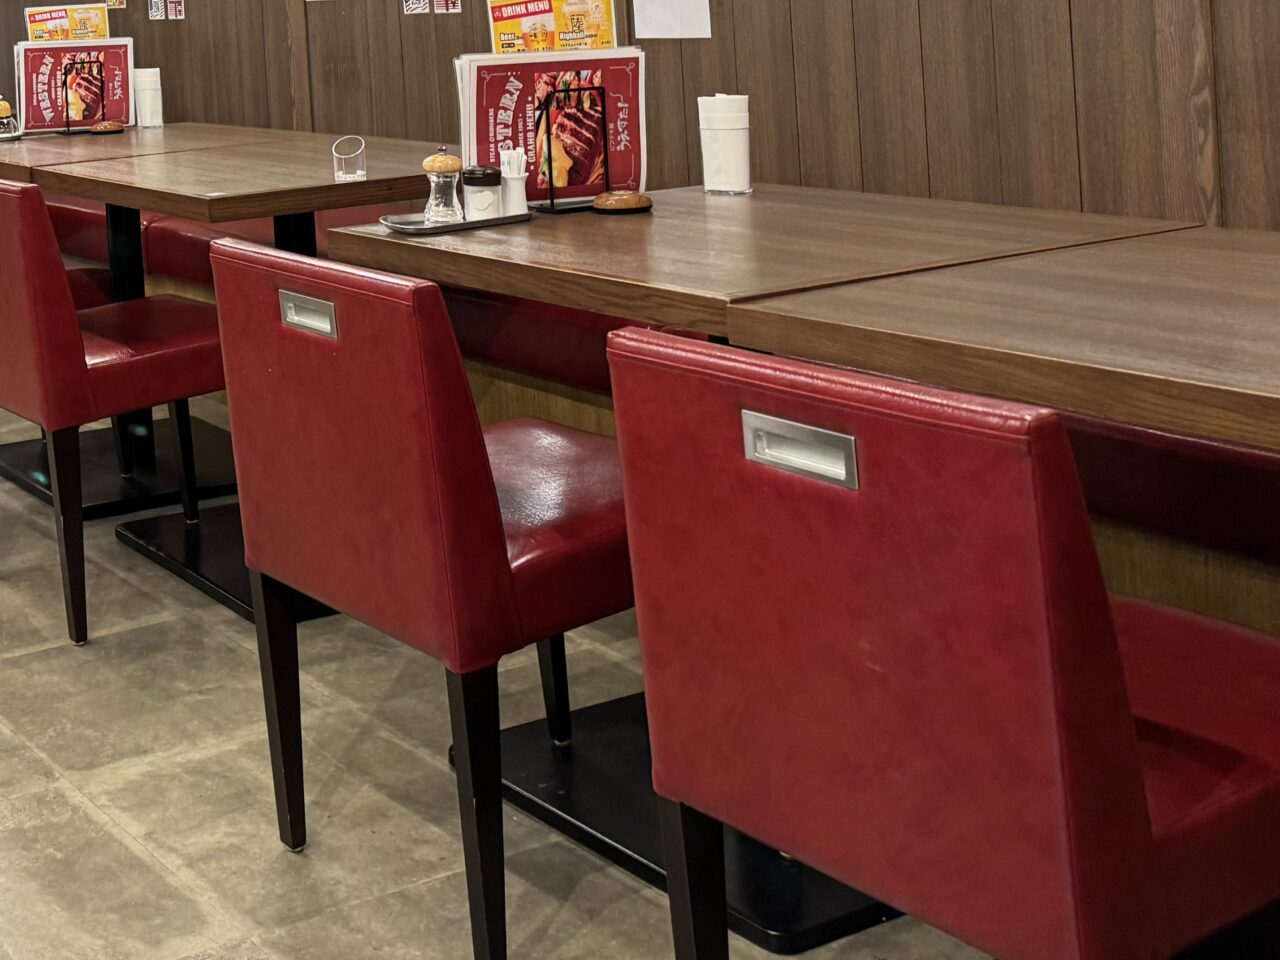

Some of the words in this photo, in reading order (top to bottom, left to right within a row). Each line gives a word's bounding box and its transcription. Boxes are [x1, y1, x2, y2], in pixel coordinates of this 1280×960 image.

[501, 4, 528, 18] DRINK
[527, 0, 550, 13] MENU
[496, 76, 523, 152] STERN
[526, 103, 535, 130] MENU
[527, 131, 536, 163] GRAND
